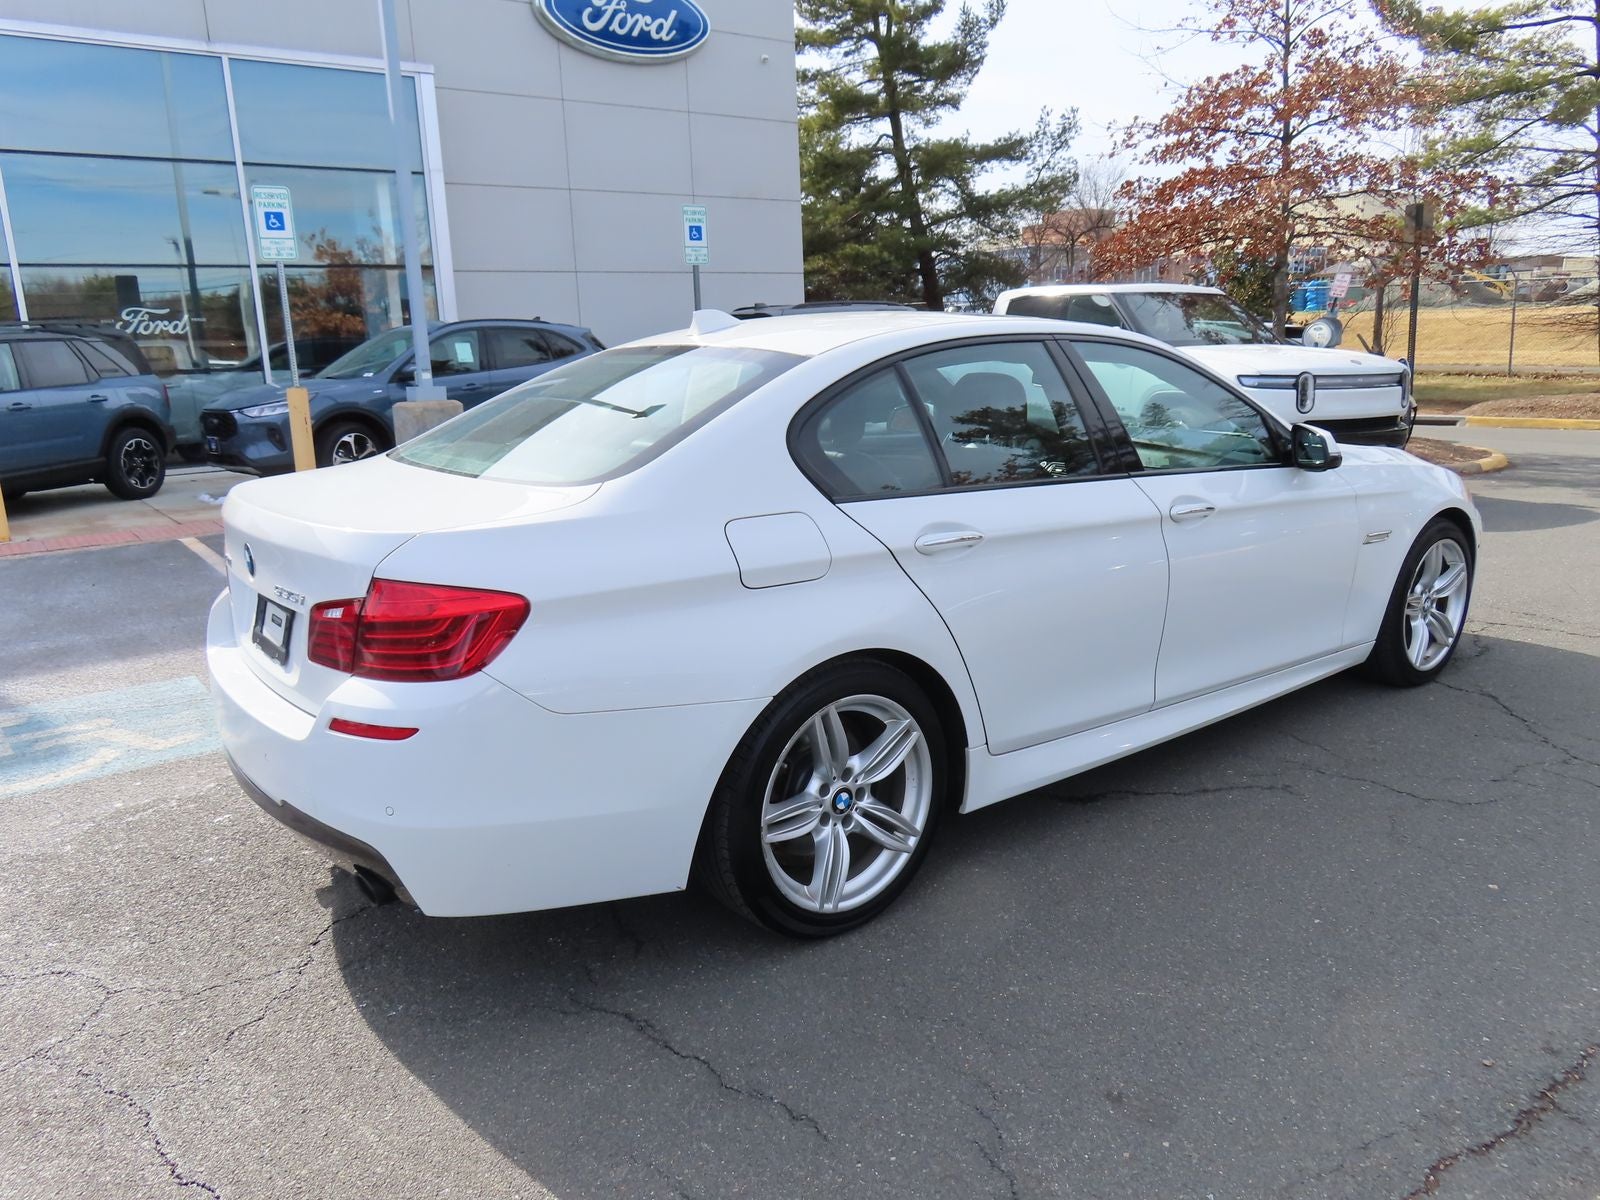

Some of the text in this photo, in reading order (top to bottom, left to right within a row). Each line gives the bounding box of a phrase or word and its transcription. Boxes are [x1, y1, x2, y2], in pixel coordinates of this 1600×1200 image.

[582, 0, 677, 42] Ford
[253, 191, 289, 200] RESERVED
[258, 201, 287, 209] PARKING
[115, 307, 189, 335] Ford
